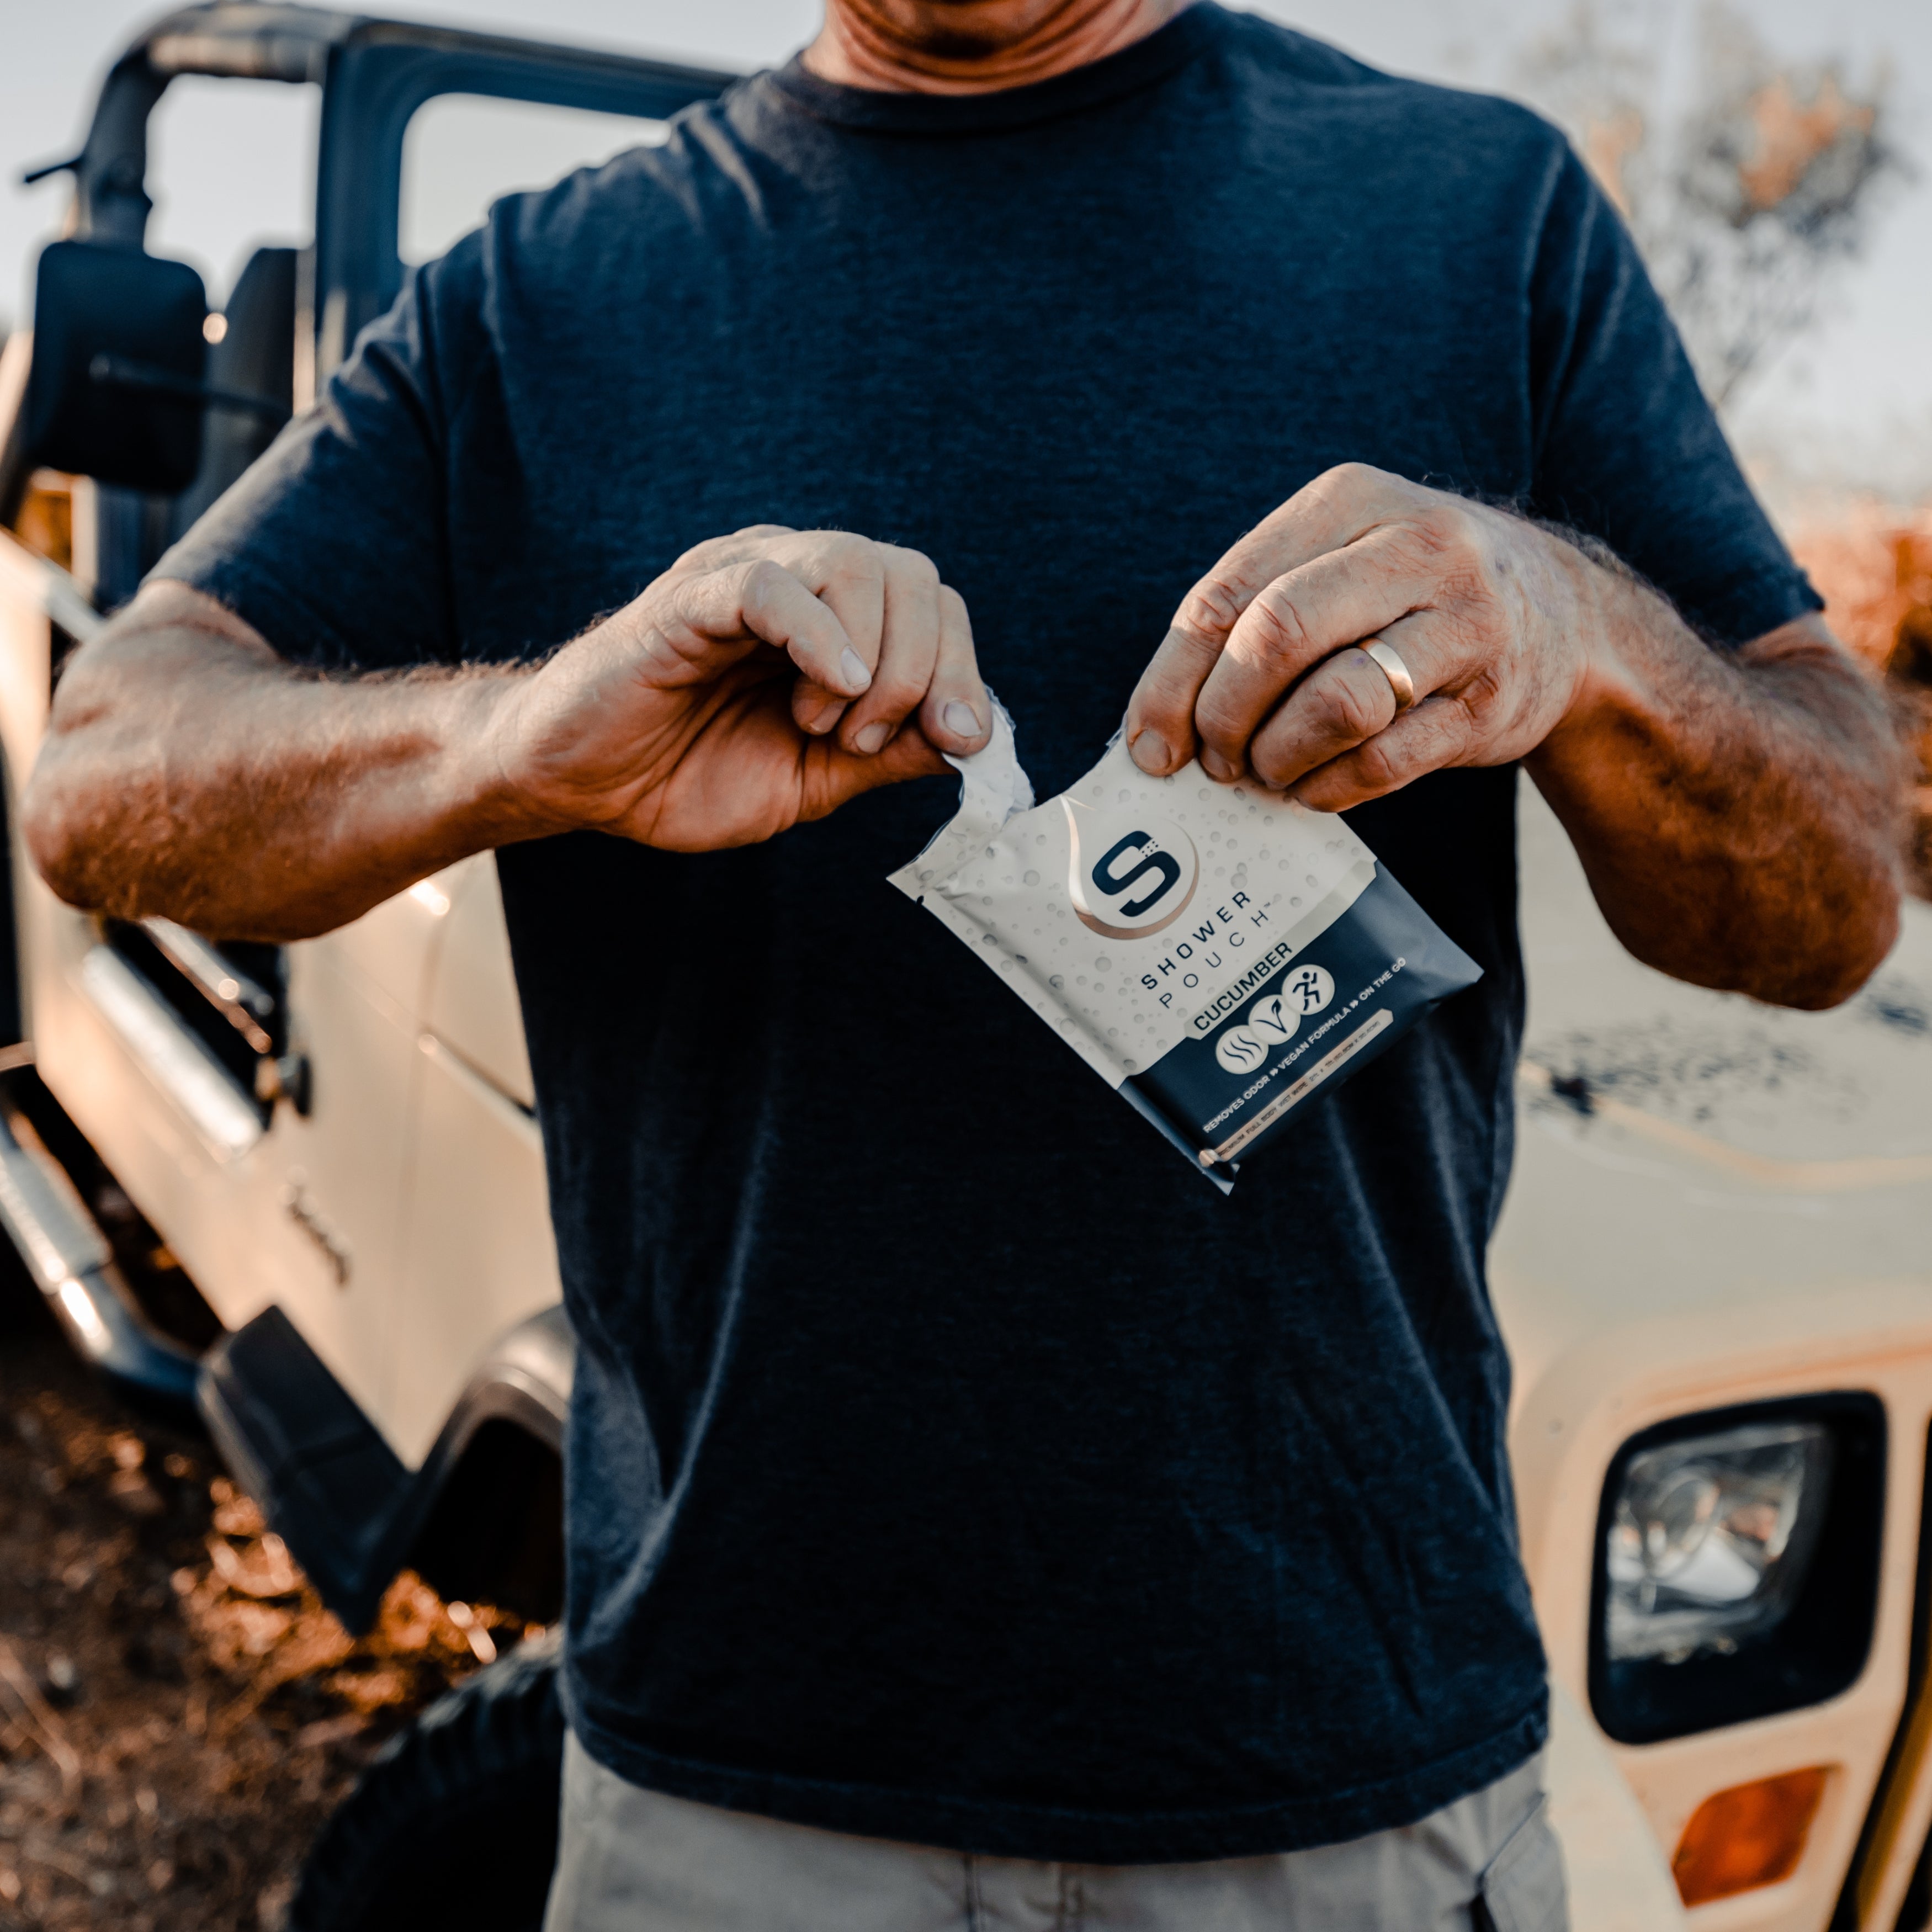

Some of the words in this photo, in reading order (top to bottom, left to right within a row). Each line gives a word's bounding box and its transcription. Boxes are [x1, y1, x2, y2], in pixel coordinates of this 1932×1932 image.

[1141, 891, 1250, 990] SHOWER
[1194, 942, 1292, 1025] CUCUMBER
[1202, 1097, 1245, 1133] REMOVES
[1243, 1075, 1270, 1100] ODOR
[1278, 1041, 1309, 1070] VEGAN
[1308, 1006, 1351, 1044] FORMULA
[1358, 985, 1375, 1001] ON
[1373, 971, 1393, 988] THE
[1392, 957, 1406, 973] GO
[1246, 1121, 1262, 1135] FULL
[1261, 1107, 1277, 1122] BODY
